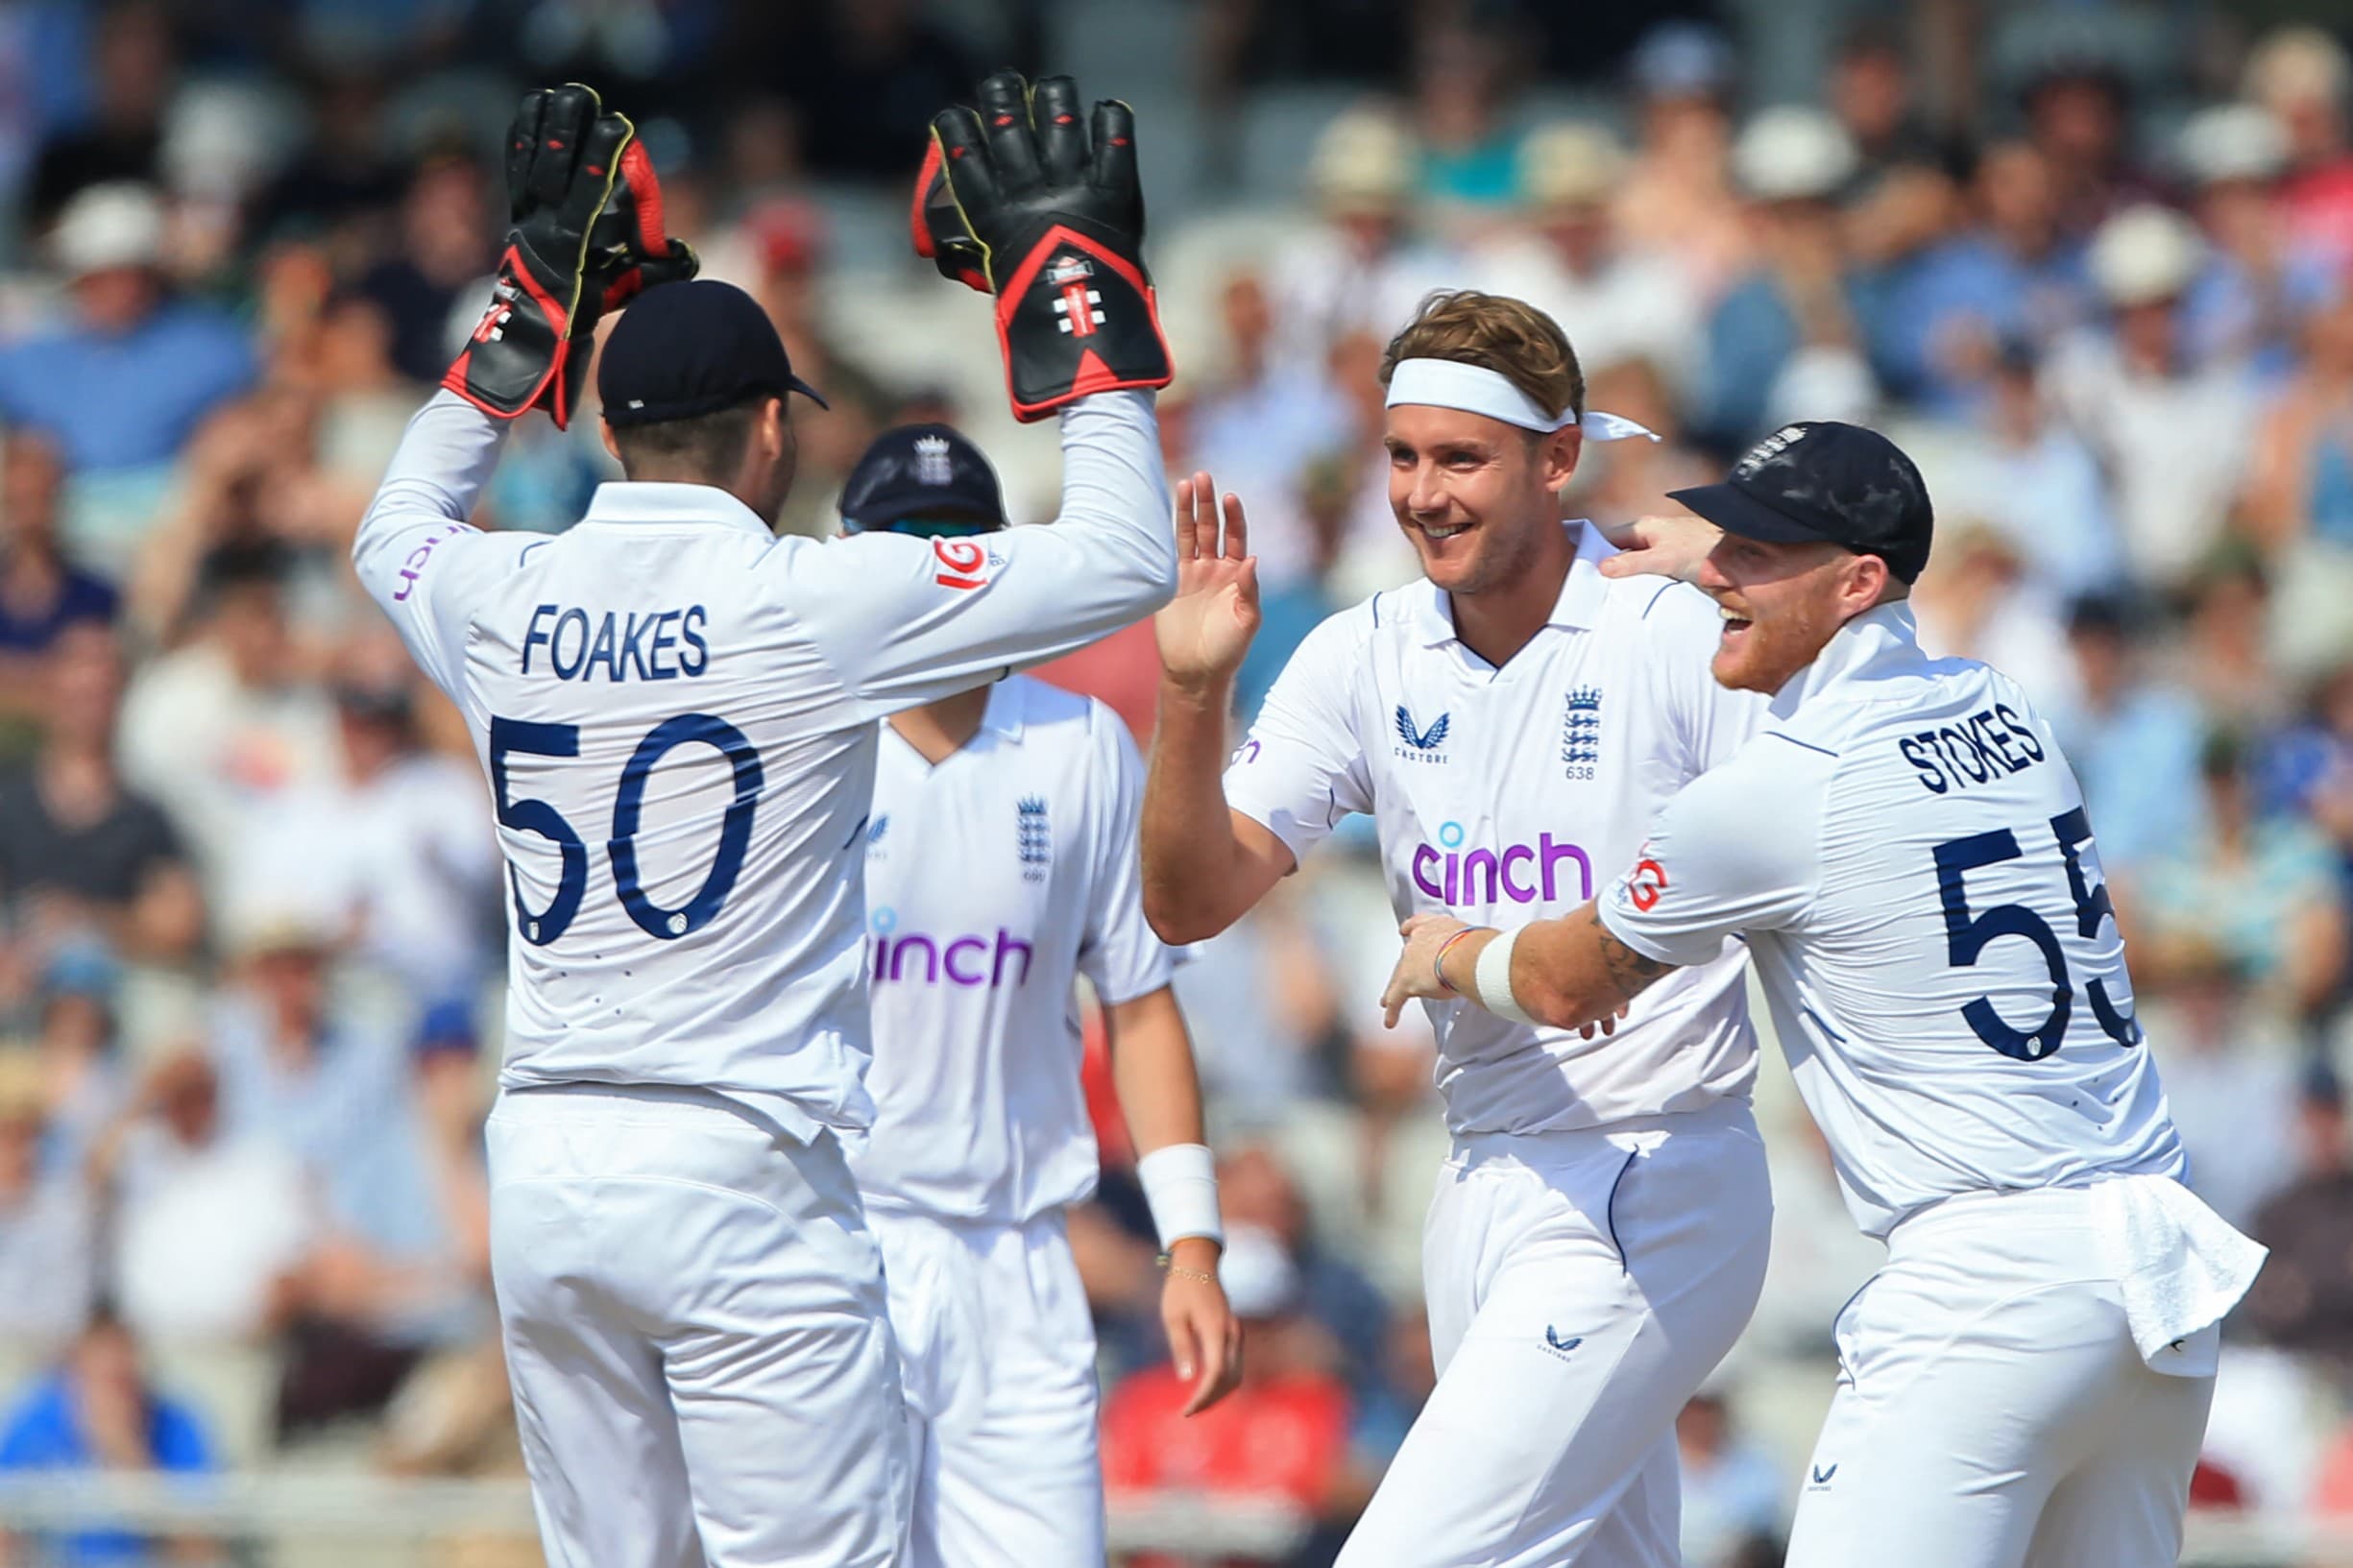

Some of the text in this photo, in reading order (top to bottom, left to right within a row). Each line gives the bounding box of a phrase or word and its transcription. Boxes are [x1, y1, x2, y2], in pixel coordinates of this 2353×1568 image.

[522, 604, 709, 682] FOAKES
[1395, 747, 1447, 764] CASTORE
[1566, 766, 1594, 780] 638
[1899, 703, 2045, 794] STOKES
[490, 712, 764, 946] 50
[1413, 821, 1593, 905] cinch
[870, 905, 1033, 988] inch
[1931, 806, 2136, 1062] 55
